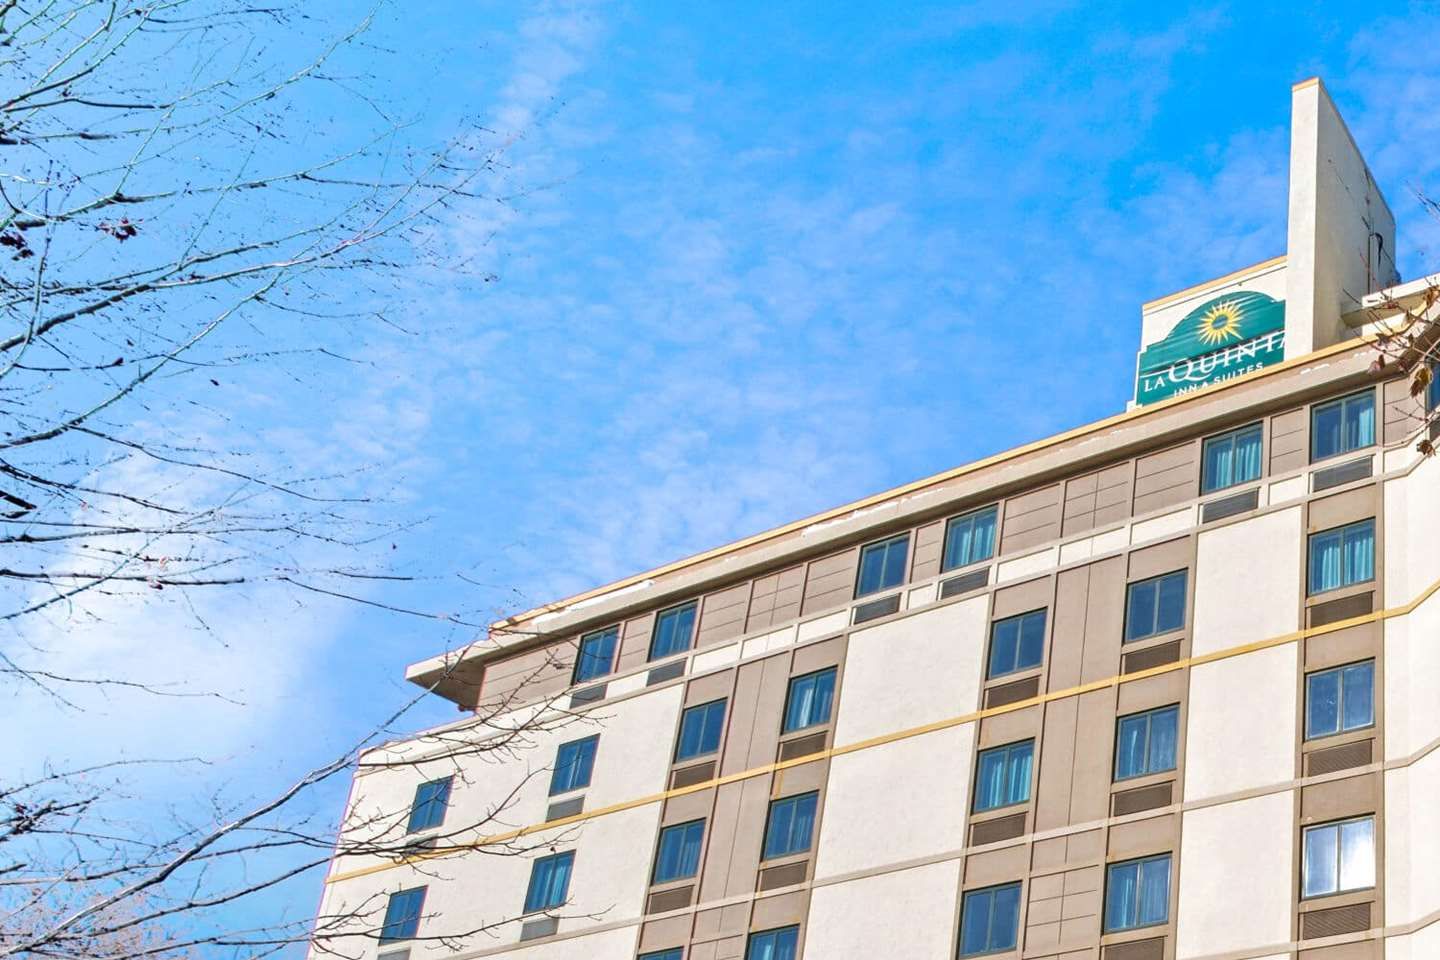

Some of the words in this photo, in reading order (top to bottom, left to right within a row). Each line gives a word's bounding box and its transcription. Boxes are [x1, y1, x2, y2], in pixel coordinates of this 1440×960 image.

[1144, 377, 1165, 392] LA
[1173, 383, 1198, 398] INN
[1213, 361, 1264, 385] SUITES
